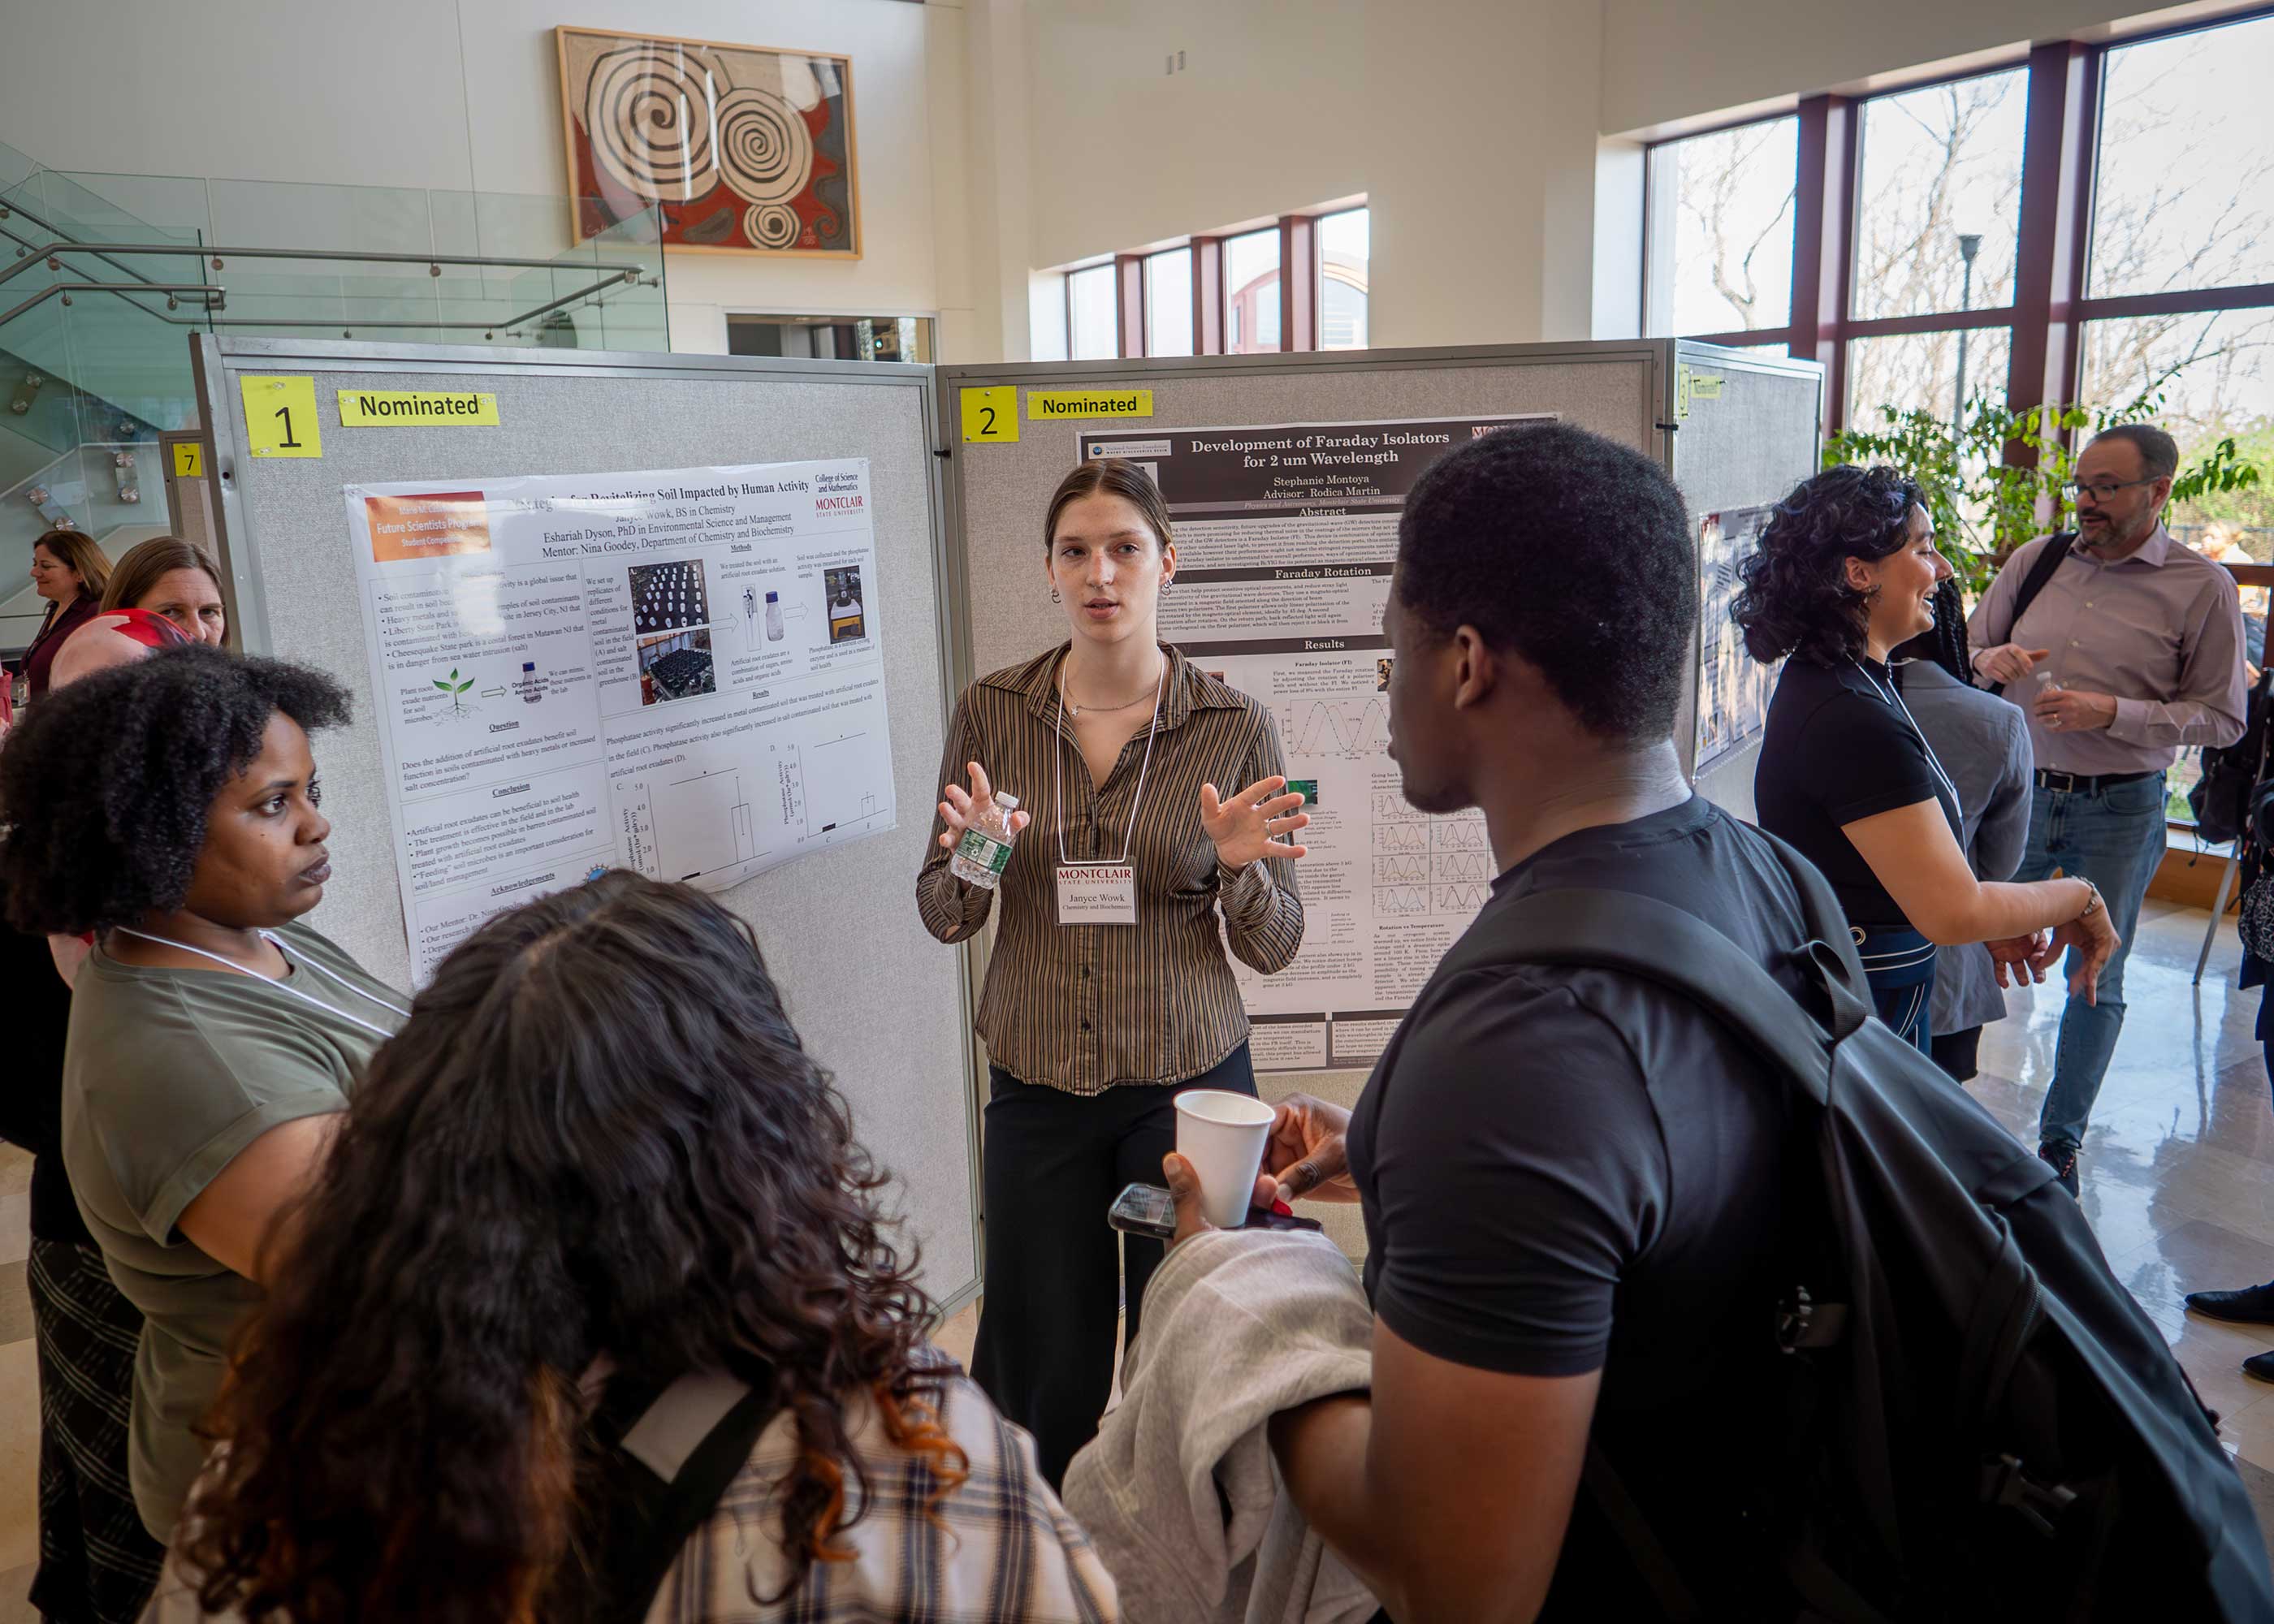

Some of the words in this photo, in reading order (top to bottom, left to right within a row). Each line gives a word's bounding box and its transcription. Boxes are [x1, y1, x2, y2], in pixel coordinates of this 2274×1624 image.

[361, 395, 479, 417] Nominated
[1043, 396, 1137, 414] Nominated
[275, 407, 301, 447] 1
[979, 408, 997, 434] 2
[1191, 438, 1292, 453] Development
[1296, 436, 1312, 448] of
[1316, 434, 1378, 448] Faraday
[1382, 433, 1449, 445] Isolators
[184, 455, 194, 471] 7
[1244, 456, 1265, 467] for
[1270, 455, 1278, 466] 2
[1283, 457, 1307, 465] um
[1310, 450, 1399, 464] Wavelength
[815, 474, 833, 485] College
[835, 473, 840, 481] of
[840, 473, 858, 481] Science
[1273, 477, 1324, 487] Stephanie
[1327, 475, 1369, 485] Montoya
[658, 489, 677, 498] Soil
[680, 486, 724, 499] Impacted
[728, 485, 738, 495] by
[741, 484, 774, 492] Human
[779, 481, 809, 491] Activity
[819, 484, 828, 493] and
[828, 482, 858, 491] Mathematics
[1264, 490, 1304, 499] Advisor:
[1310, 488, 1342, 497] Rodica
[1346, 486, 1380, 495] Martin
[816, 495, 863, 510] MONTCLAIR
[647, 508, 673, 519] Wowk,
[676, 508, 688, 516] BS
[698, 505, 735, 516] Chemistry
[834, 508, 863, 516] UNIVERSITY
[1299, 508, 1346, 516] Abstract
[377, 523, 405, 534] Future
[407, 520, 447, 532] Scientists
[544, 530, 582, 543] Eshariah
[585, 529, 616, 541] Dyson,
[617, 525, 636, 536] PhD
[648, 519, 704, 533] Environmental
[706, 519, 733, 528] Science
[735, 516, 747, 525] and
[750, 513, 791, 525] Management
[401, 538, 426, 547] Student
[426, 536, 465, 546] Compet
[543, 547, 578, 558] Mentor:
[580, 544, 602, 554] Nina
[604, 540, 639, 551] Goodey,
[642, 536, 686, 549] Department
[689, 533, 697, 542] of
[698, 533, 735, 542] Chemistry
[737, 528, 750, 538] and
[751, 526, 793, 537] Biochemistry
[731, 543, 752, 552] Methods
[1275, 569, 1321, 578] Faraday
[1325, 568, 1371, 577] Rotation
[586, 587, 614, 597] replicates
[1305, 640, 1344, 649] Results
[752, 690, 769, 700] Results
[605, 733, 642, 745] Phosphatase
[643, 728, 664, 737] activity
[665, 719, 700, 733] significantly
[702, 713, 726, 724] increased
[733, 708, 747, 717] metal
[748, 701, 780, 714] contaminated
[836, 684, 853, 693] artificial
[489, 721, 520, 733] Question
[401, 762, 422, 770] Does
[435, 754, 463, 763] addition
[465, 749, 473, 758] of
[474, 744, 500, 756] artificial
[517, 737, 543, 747] exudates
[544, 732, 565, 742] benefit
[404, 771, 434, 781] function
[443, 764, 460, 773] soils
[461, 754, 504, 770] contaminated
[506, 751, 520, 759] with
[521, 749, 539, 757] heavy
[541, 743, 560, 753] metals
[569, 735, 595, 747] increased
[611, 766, 634, 778] artificial
[636, 764, 647, 772] root
[648, 758, 673, 768] exudates
[674, 754, 686, 763] (D).
[404, 783, 418, 792] salt
[420, 772, 469, 789] concentration?
[492, 784, 530, 797] Conclusion
[409, 823, 442, 836] Artificial
[460, 814, 488, 825] exudates
[512, 800, 542, 813] beneficial
[551, 795, 560, 804] soil
[562, 791, 580, 801] health
[1058, 869, 1131, 879] MONTCLAIR
[491, 873, 555, 896] Acknowledgements
[1070, 894, 1096, 903] Janyce
[1100, 894, 1124, 902] Wowk
